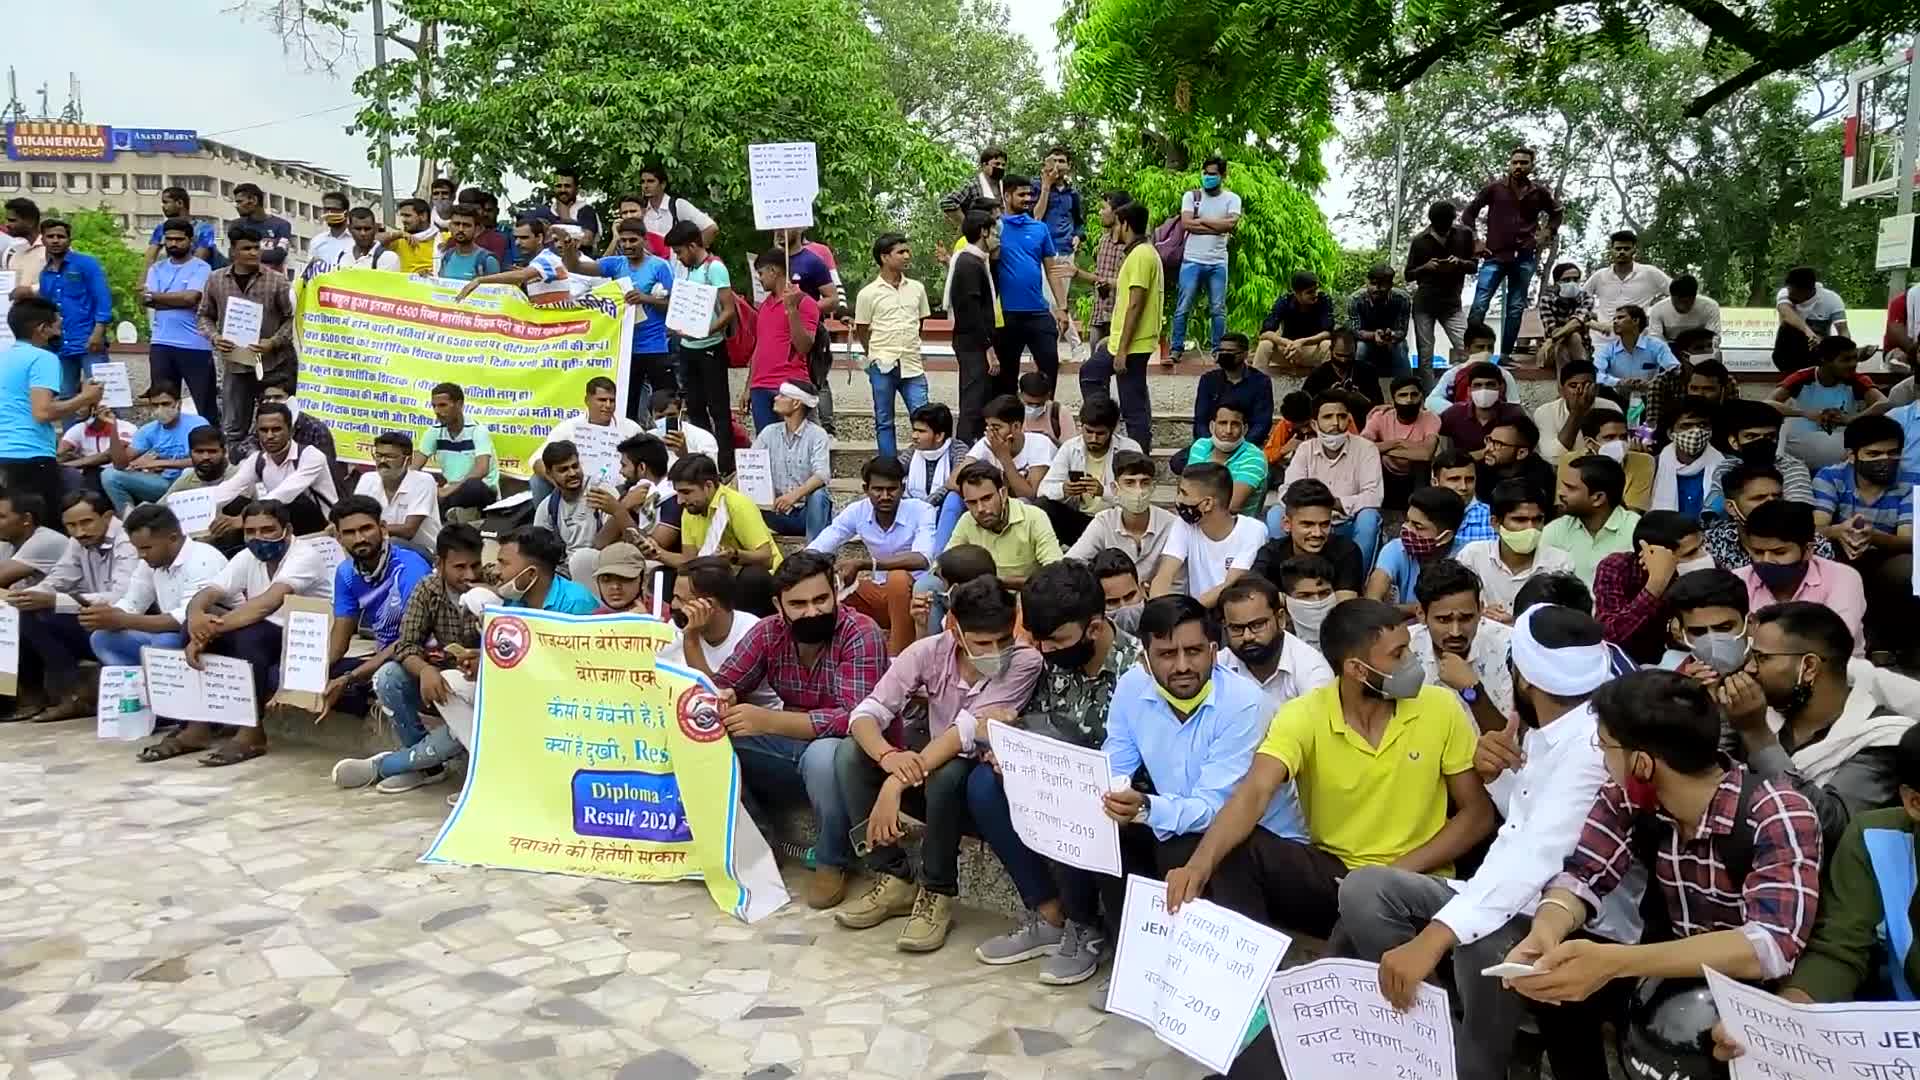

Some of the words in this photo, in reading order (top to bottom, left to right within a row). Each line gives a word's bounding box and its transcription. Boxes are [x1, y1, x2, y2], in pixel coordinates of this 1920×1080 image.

[13, 135, 104, 148] BIKANERVALA
[395, 304, 418, 318] 6500
[447, 336, 472, 348] 6500
[391, 411, 408, 422] और
[502, 424, 527, 435] 50%
[594, 629, 652, 652] बेरोजगार
[544, 732, 573, 755] क्यों
[591, 782, 660, 804] Diploma
[583, 806, 636, 827] Result
[640, 811, 677, 831] 2020
[564, 840, 587, 860] की
[589, 841, 634, 865] हितैषी
[1056, 839, 1081, 858] 2100
[1151, 894, 1166, 913] नि
[1235, 935, 1260, 957] राज
[1141, 920, 1169, 937] JEN
[1176, 930, 1221, 965] विज्ञप्ति
[1226, 957, 1256, 980] जारी
[1293, 994, 1360, 1022] विज्ञप्ति
[1296, 1026, 1343, 1048] बजट
[1743, 1023, 1836, 1074] विज्ञप्ति
[1815, 1028, 1867, 1048] राज
[1331, 1050, 1357, 1066] पद
